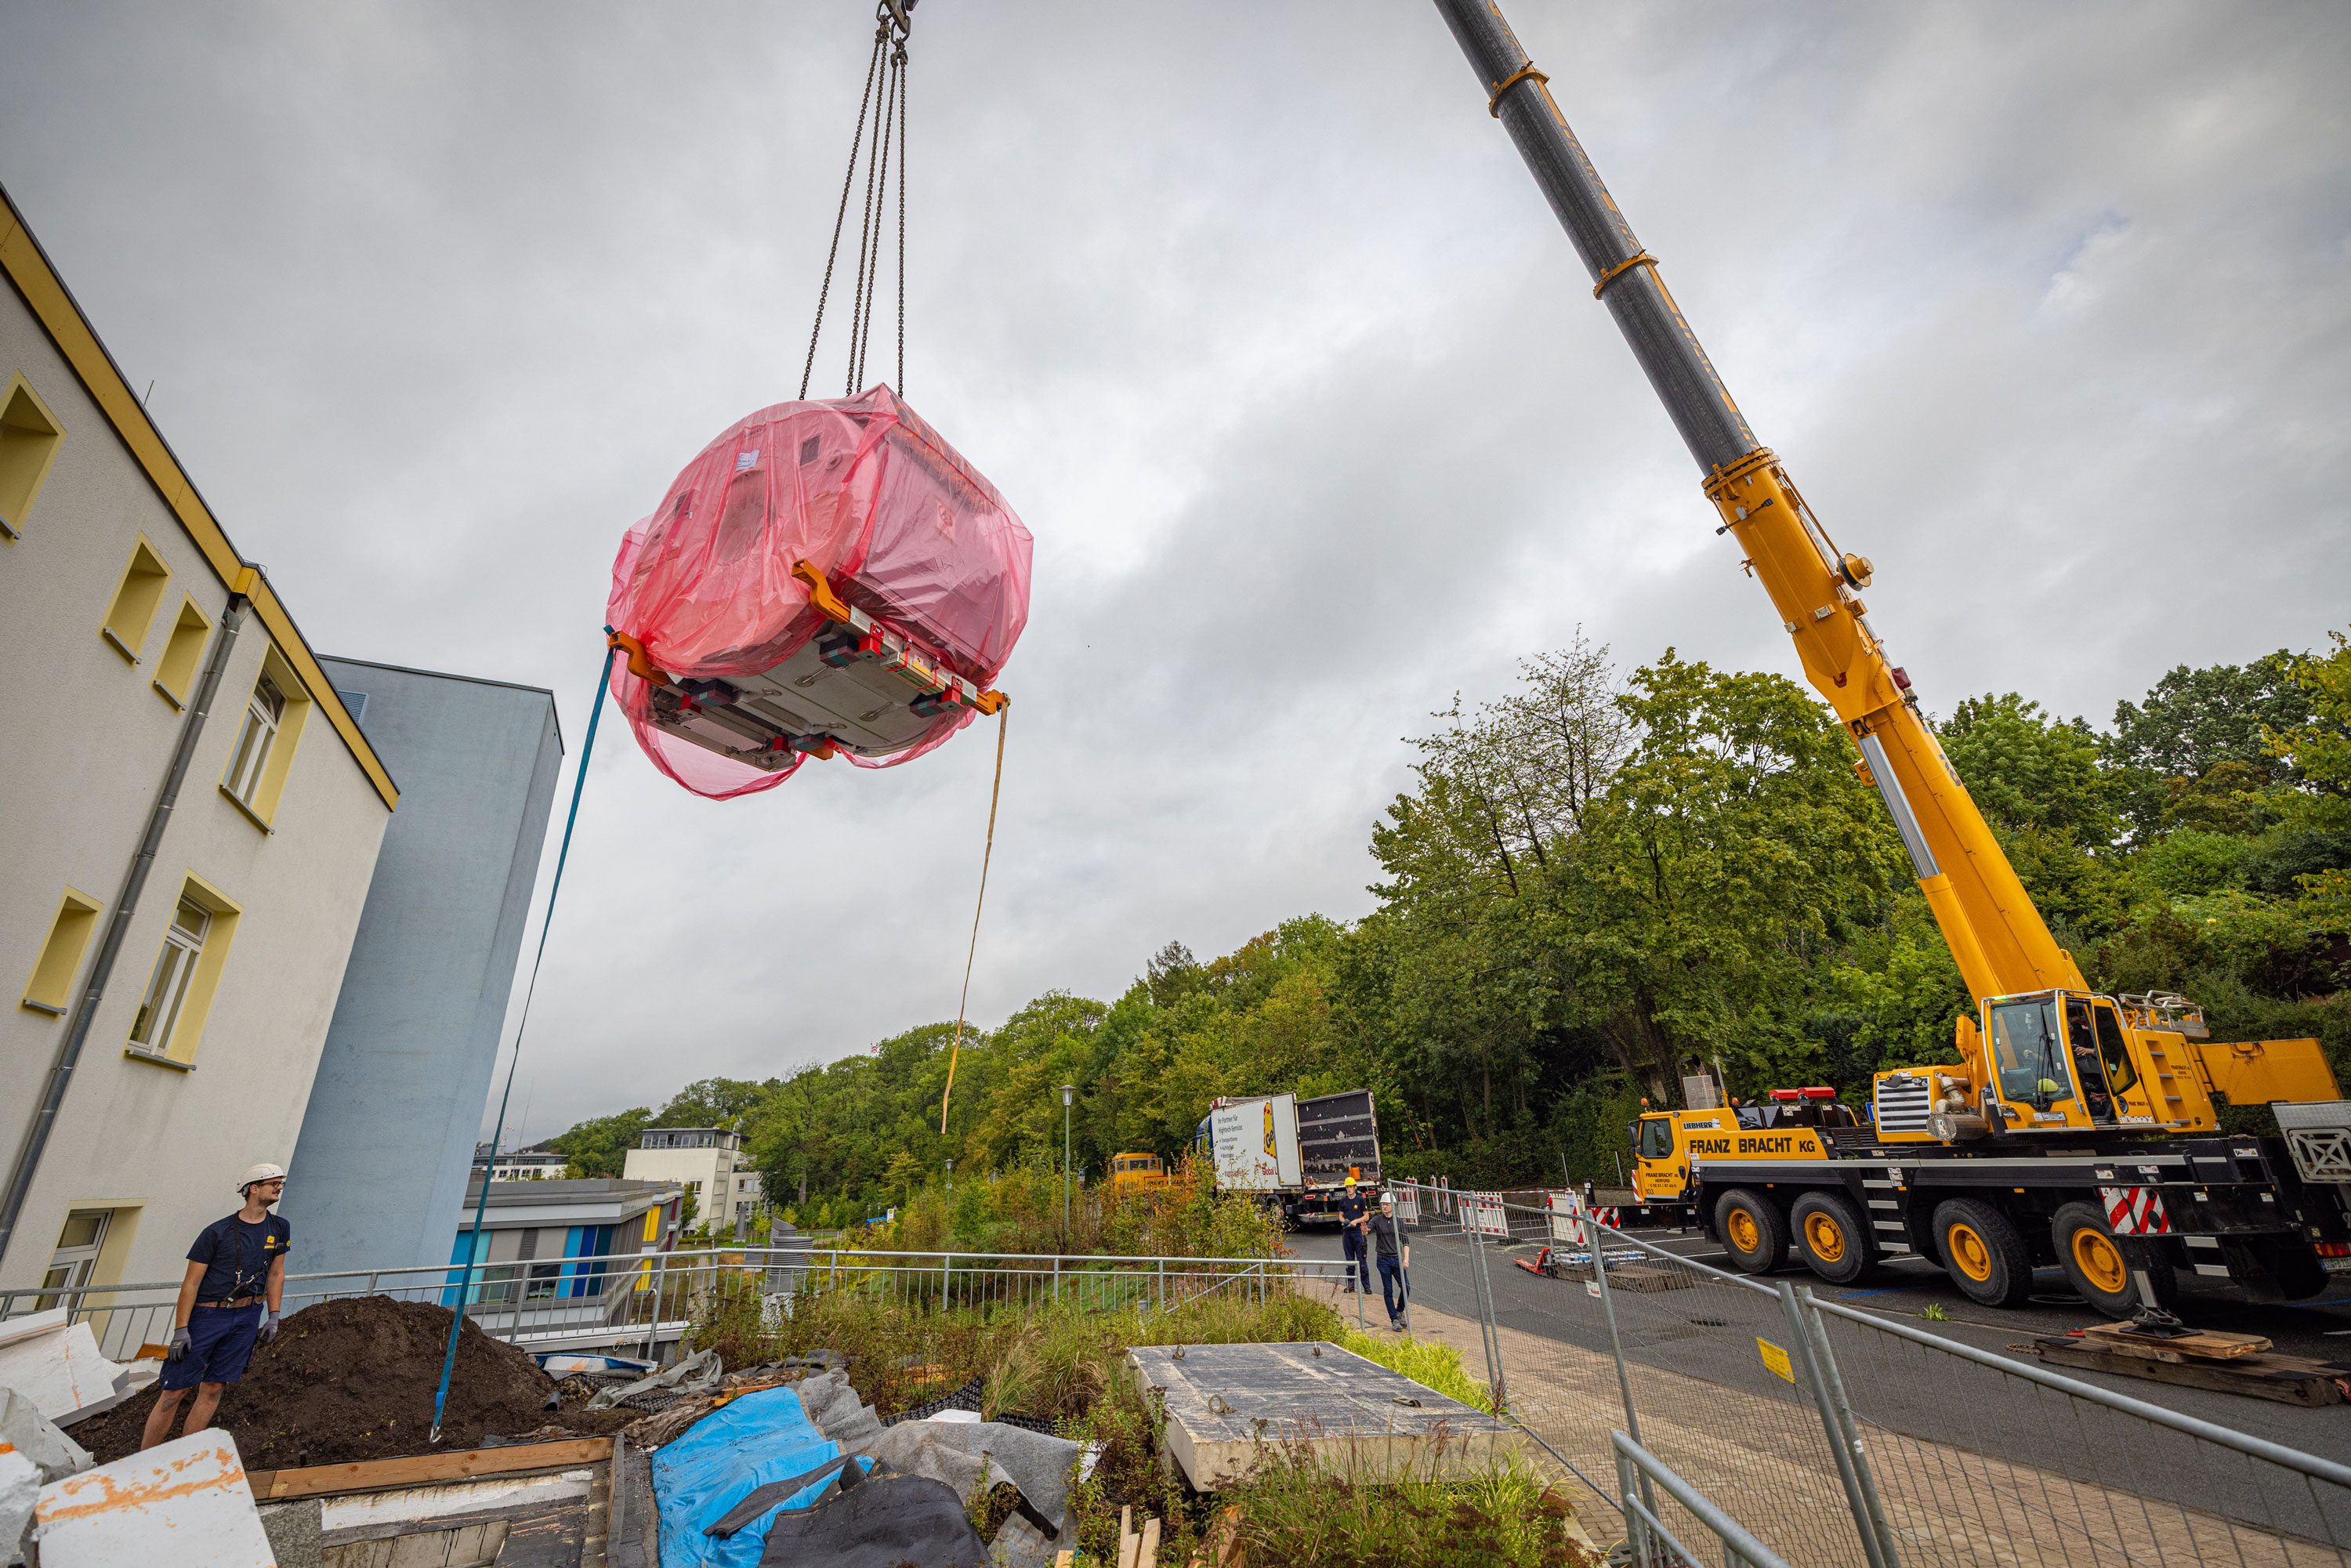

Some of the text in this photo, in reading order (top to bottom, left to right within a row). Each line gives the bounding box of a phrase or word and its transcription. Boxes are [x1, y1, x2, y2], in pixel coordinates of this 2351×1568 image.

[1690, 1137, 1815, 1153] FRANZ BRACHT KG
